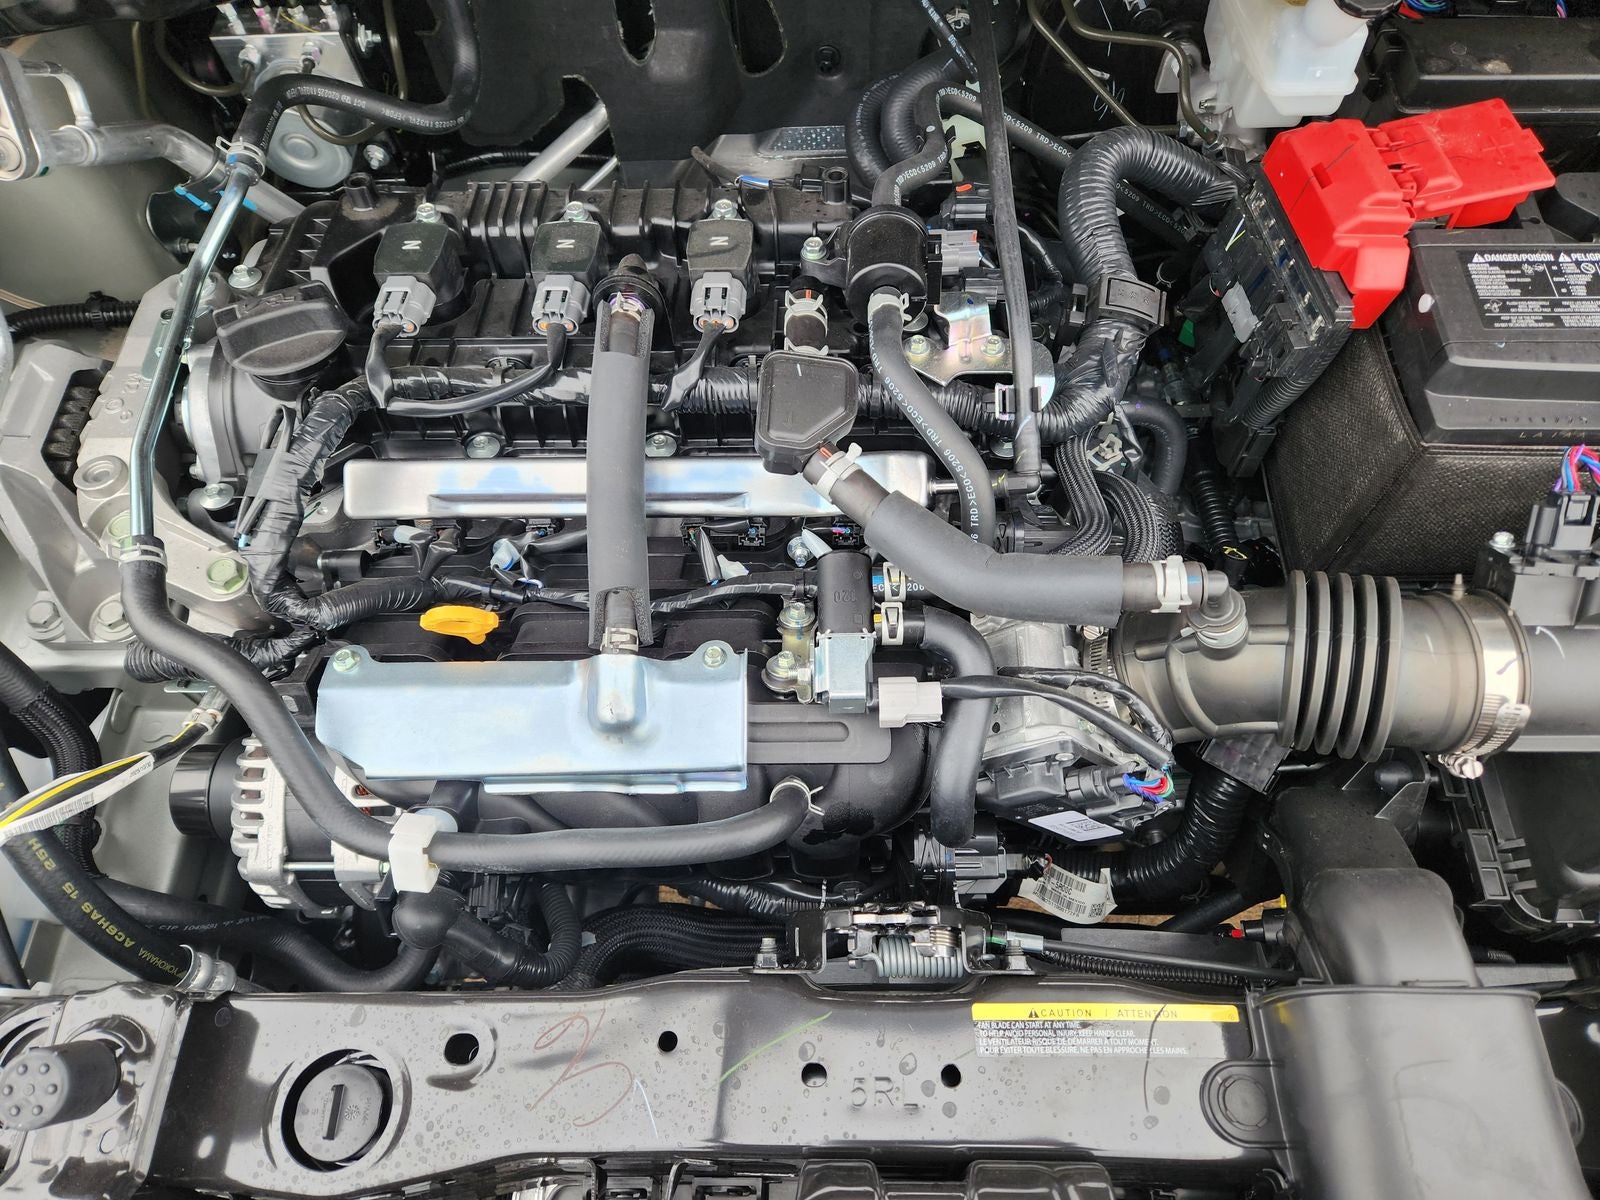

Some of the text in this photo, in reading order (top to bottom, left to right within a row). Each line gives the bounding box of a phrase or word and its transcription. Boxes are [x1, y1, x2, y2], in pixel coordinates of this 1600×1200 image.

[1484, 253, 1555, 262] DANGER/POISON
[139, 947, 180, 976] YOKOHAMA
[1040, 1008, 1178, 1019] CAUTION ATTENTON
[991, 1021, 1011, 1029] BLADE
[1011, 1021, 1025, 1029] CAN
[1025, 1021, 1043, 1029] START
[1044, 1021, 1052, 1029] AT
[1053, 1021, 1065, 1029] ANY
[988, 1029, 1004, 1037] HELP
[1004, 1029, 1024, 1037] AVOID
[1024, 1029, 1056, 1037] PERSONAL
[1078, 1029, 1092, 1037] KEEP
[1094, 1029, 1115, 1037] HANDS
[1110, 1038, 1127, 1046] TOUT
[979, 1046, 1000, 1054] POUR
[1023, 1046, 1045, 1054] TOUTE
[1079, 1046, 1090, 1054] NE
[1090, 1046, 1103, 1054] PAS
[1103, 1046, 1113, 1054] EN
